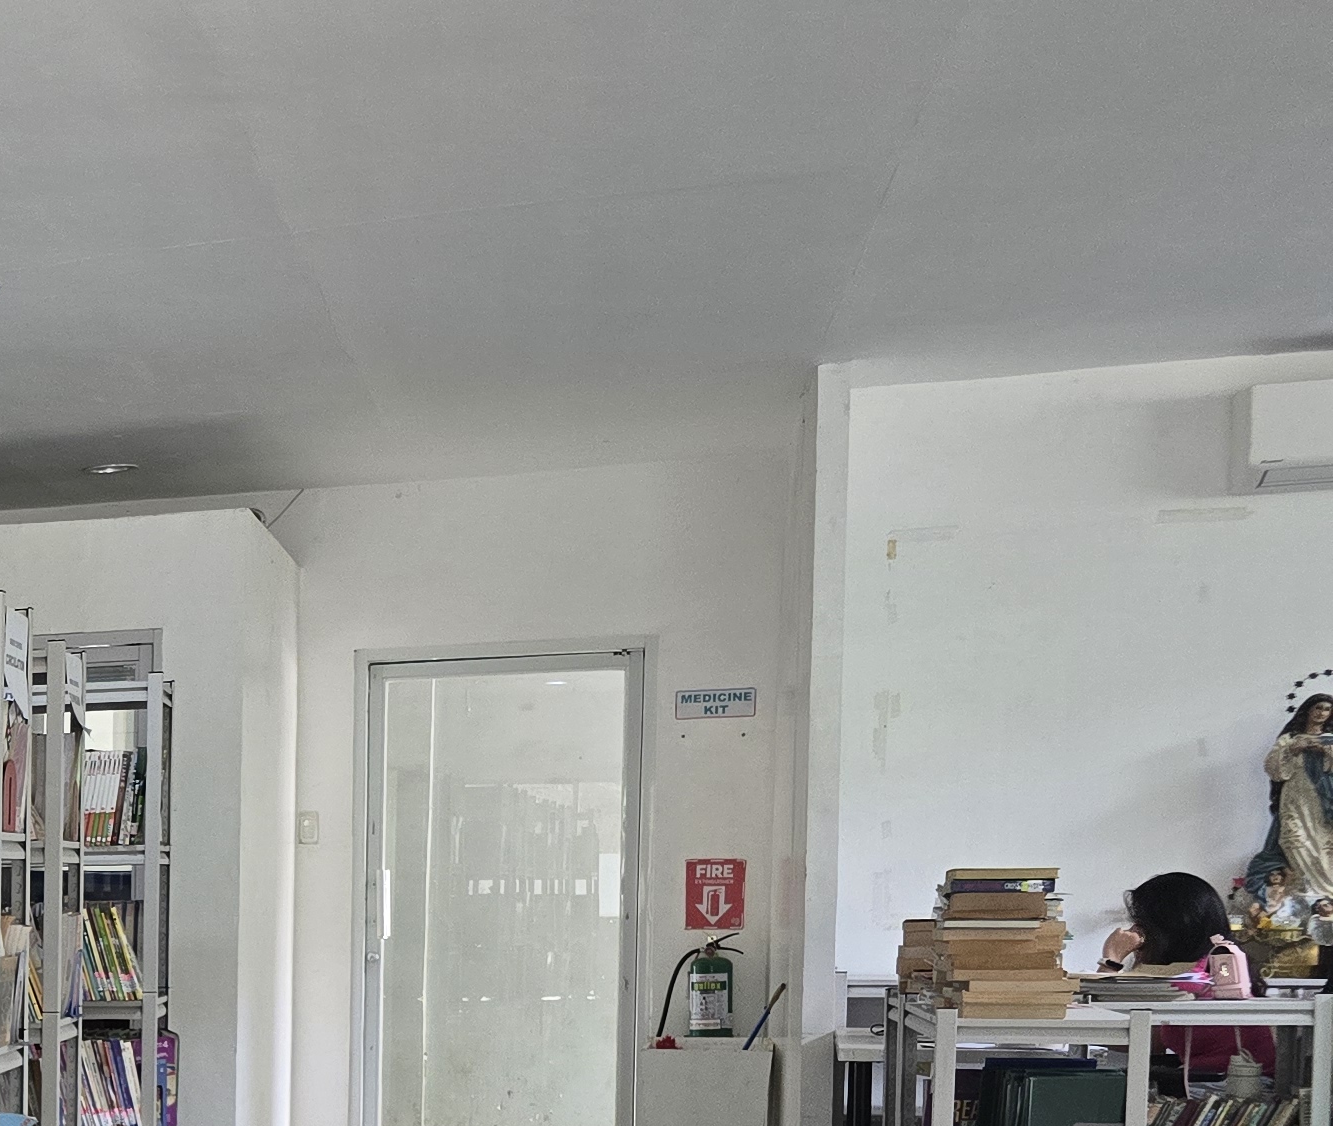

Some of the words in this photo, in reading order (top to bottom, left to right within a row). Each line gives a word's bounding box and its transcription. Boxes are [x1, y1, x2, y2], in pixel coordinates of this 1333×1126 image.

[681, 691, 753, 704] MEDICINE
[703, 704, 729, 715] KIT
[695, 864, 734, 878] FIRE
